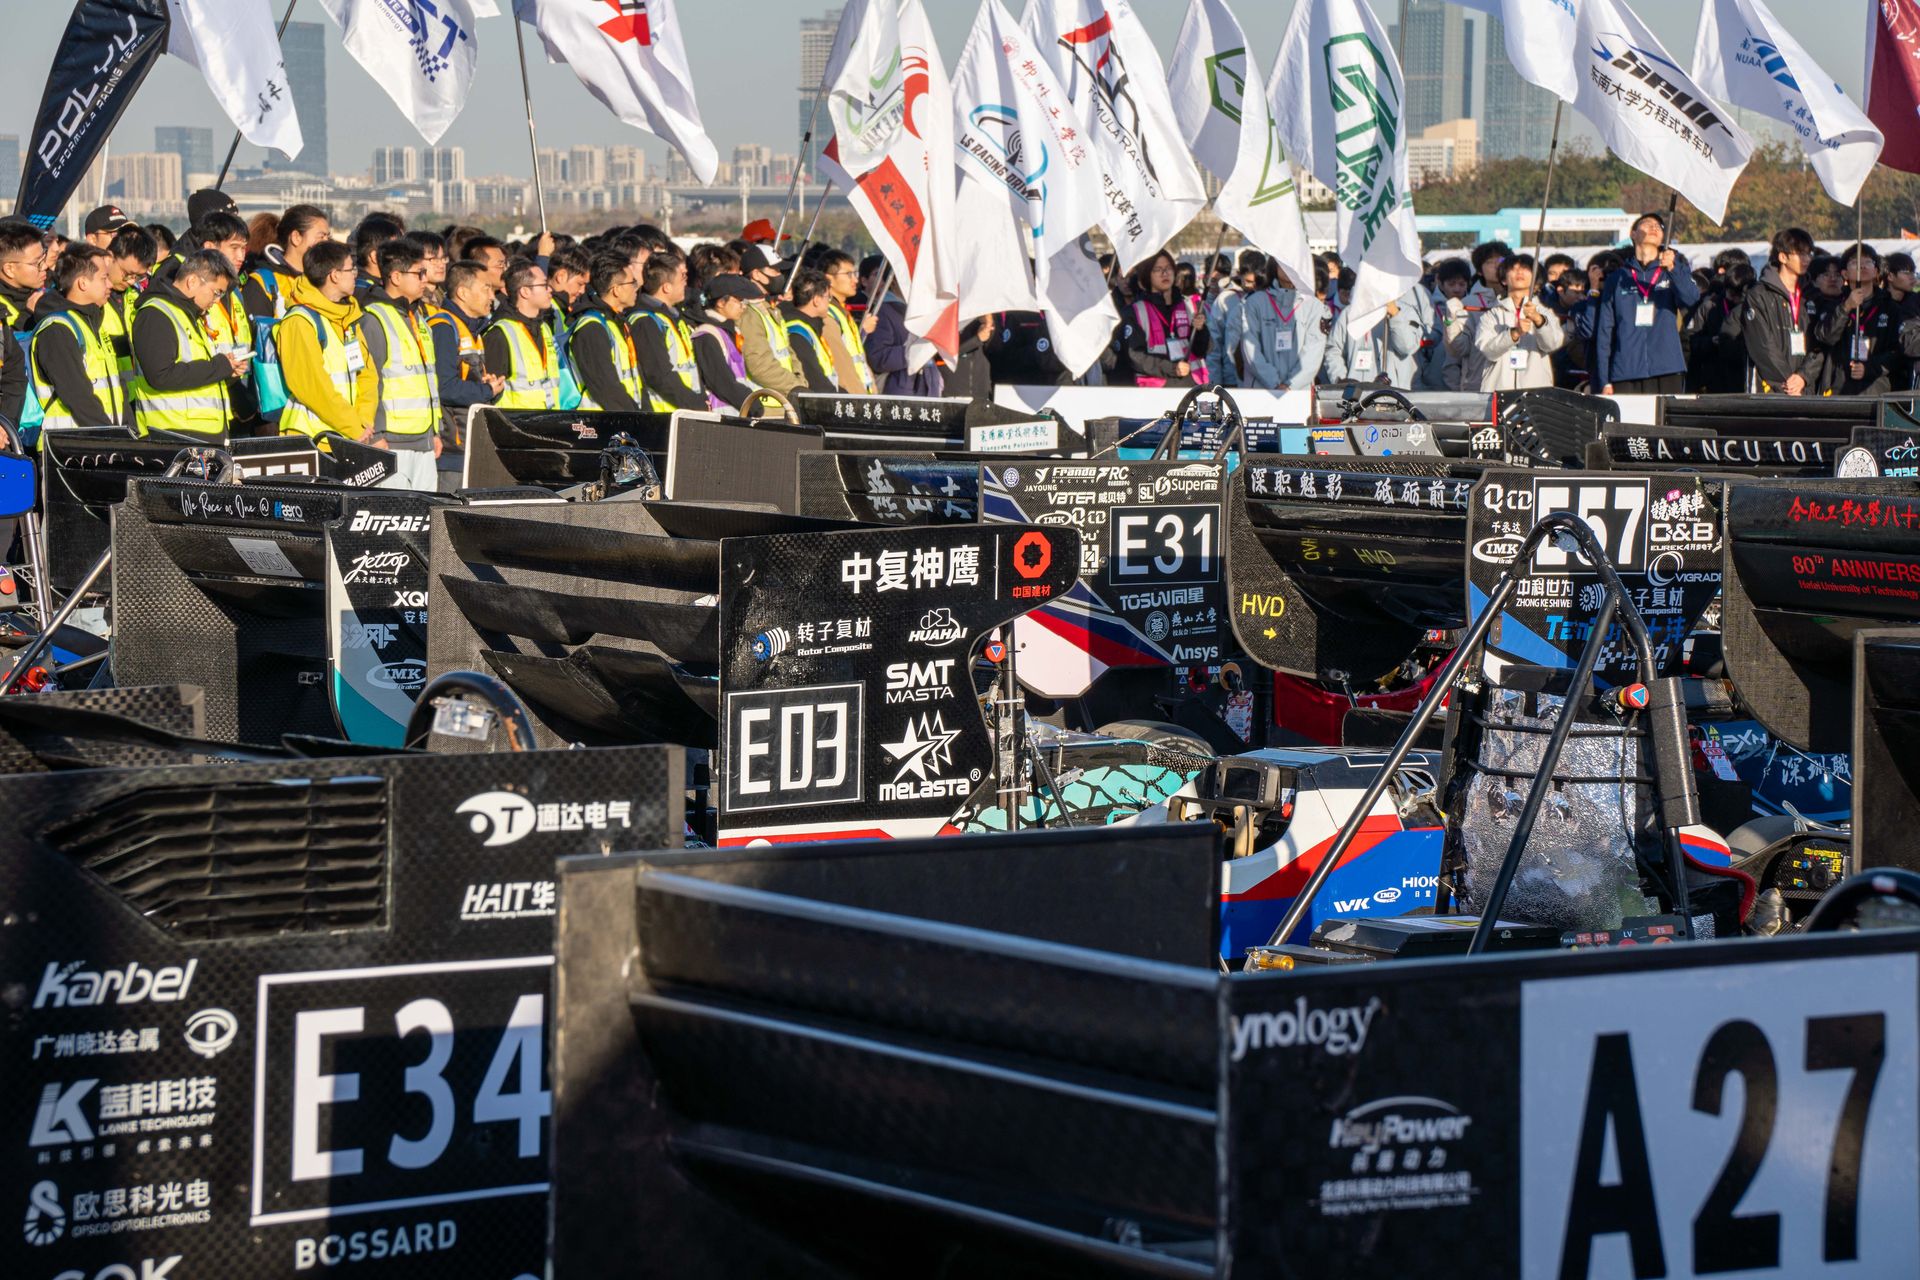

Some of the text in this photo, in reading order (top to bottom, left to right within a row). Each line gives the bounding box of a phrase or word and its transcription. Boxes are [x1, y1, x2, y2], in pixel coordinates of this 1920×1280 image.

[1735, 52, 1762, 67] NUAA
[52, 112, 97, 179] E-FORMULA
[96, 67, 123, 111] RACING
[1791, 120, 1810, 138] ING
[959, 133, 975, 148] LS
[970, 143, 1009, 176] RACING
[1119, 136, 1157, 199] RACING
[1702, 439, 1760, 462] NCU
[1773, 440, 1823, 462] 101
[354, 461, 385, 487] BENDER
[1052, 467, 1097, 477] Frando
[1024, 485, 1058, 493] JAYOUNG
[1140, 487, 1153, 500] SL
[1171, 478, 1206, 494] Super
[1251, 468, 1469, 508] 深职魅影 砥砺前行
[1492, 521, 1521, 533] 千丞达
[1651, 523, 1713, 541] C&B
[1119, 513, 1212, 576] E31
[1486, 543, 1519, 554] IMK
[344, 550, 410, 584] jettop
[1354, 548, 1396, 565] HVD
[841, 546, 980, 594] 中复神鹰
[1013, 585, 1052, 598] 中国建材
[1517, 578, 1574, 597] 中科世为
[1822, 582, 1860, 596] University
[1871, 585, 1919, 600] Technology
[1242, 593, 1285, 617] HVD
[1516, 599, 1540, 607] ZHONG
[1560, 599, 1573, 608] WEI
[1640, 607, 1683, 615] Composite
[797, 617, 872, 643] 转子复材
[908, 627, 968, 642] HUAHAI
[797, 643, 873, 657] Rotor Composite
[1172, 644, 1218, 662] Ansys
[382, 668, 421, 680] IMK
[886, 659, 955, 690] SMT
[886, 688, 955, 704] MASTA
[739, 702, 848, 795] E03
[536, 801, 632, 832] 通达电气
[99, 1076, 217, 1119] 蓝科科技
[292, 994, 552, 1182] E34
[140, 1112, 216, 1133] TECHNOLOGY
[1329, 1114, 1472, 1154] KeyPower
[1558, 1011, 1886, 1280] A27
[72, 1177, 211, 1222] 欧思科光电
[110, 1210, 211, 1233] OPTOELECTRONICS
[295, 1219, 458, 1271] BOSSARD
